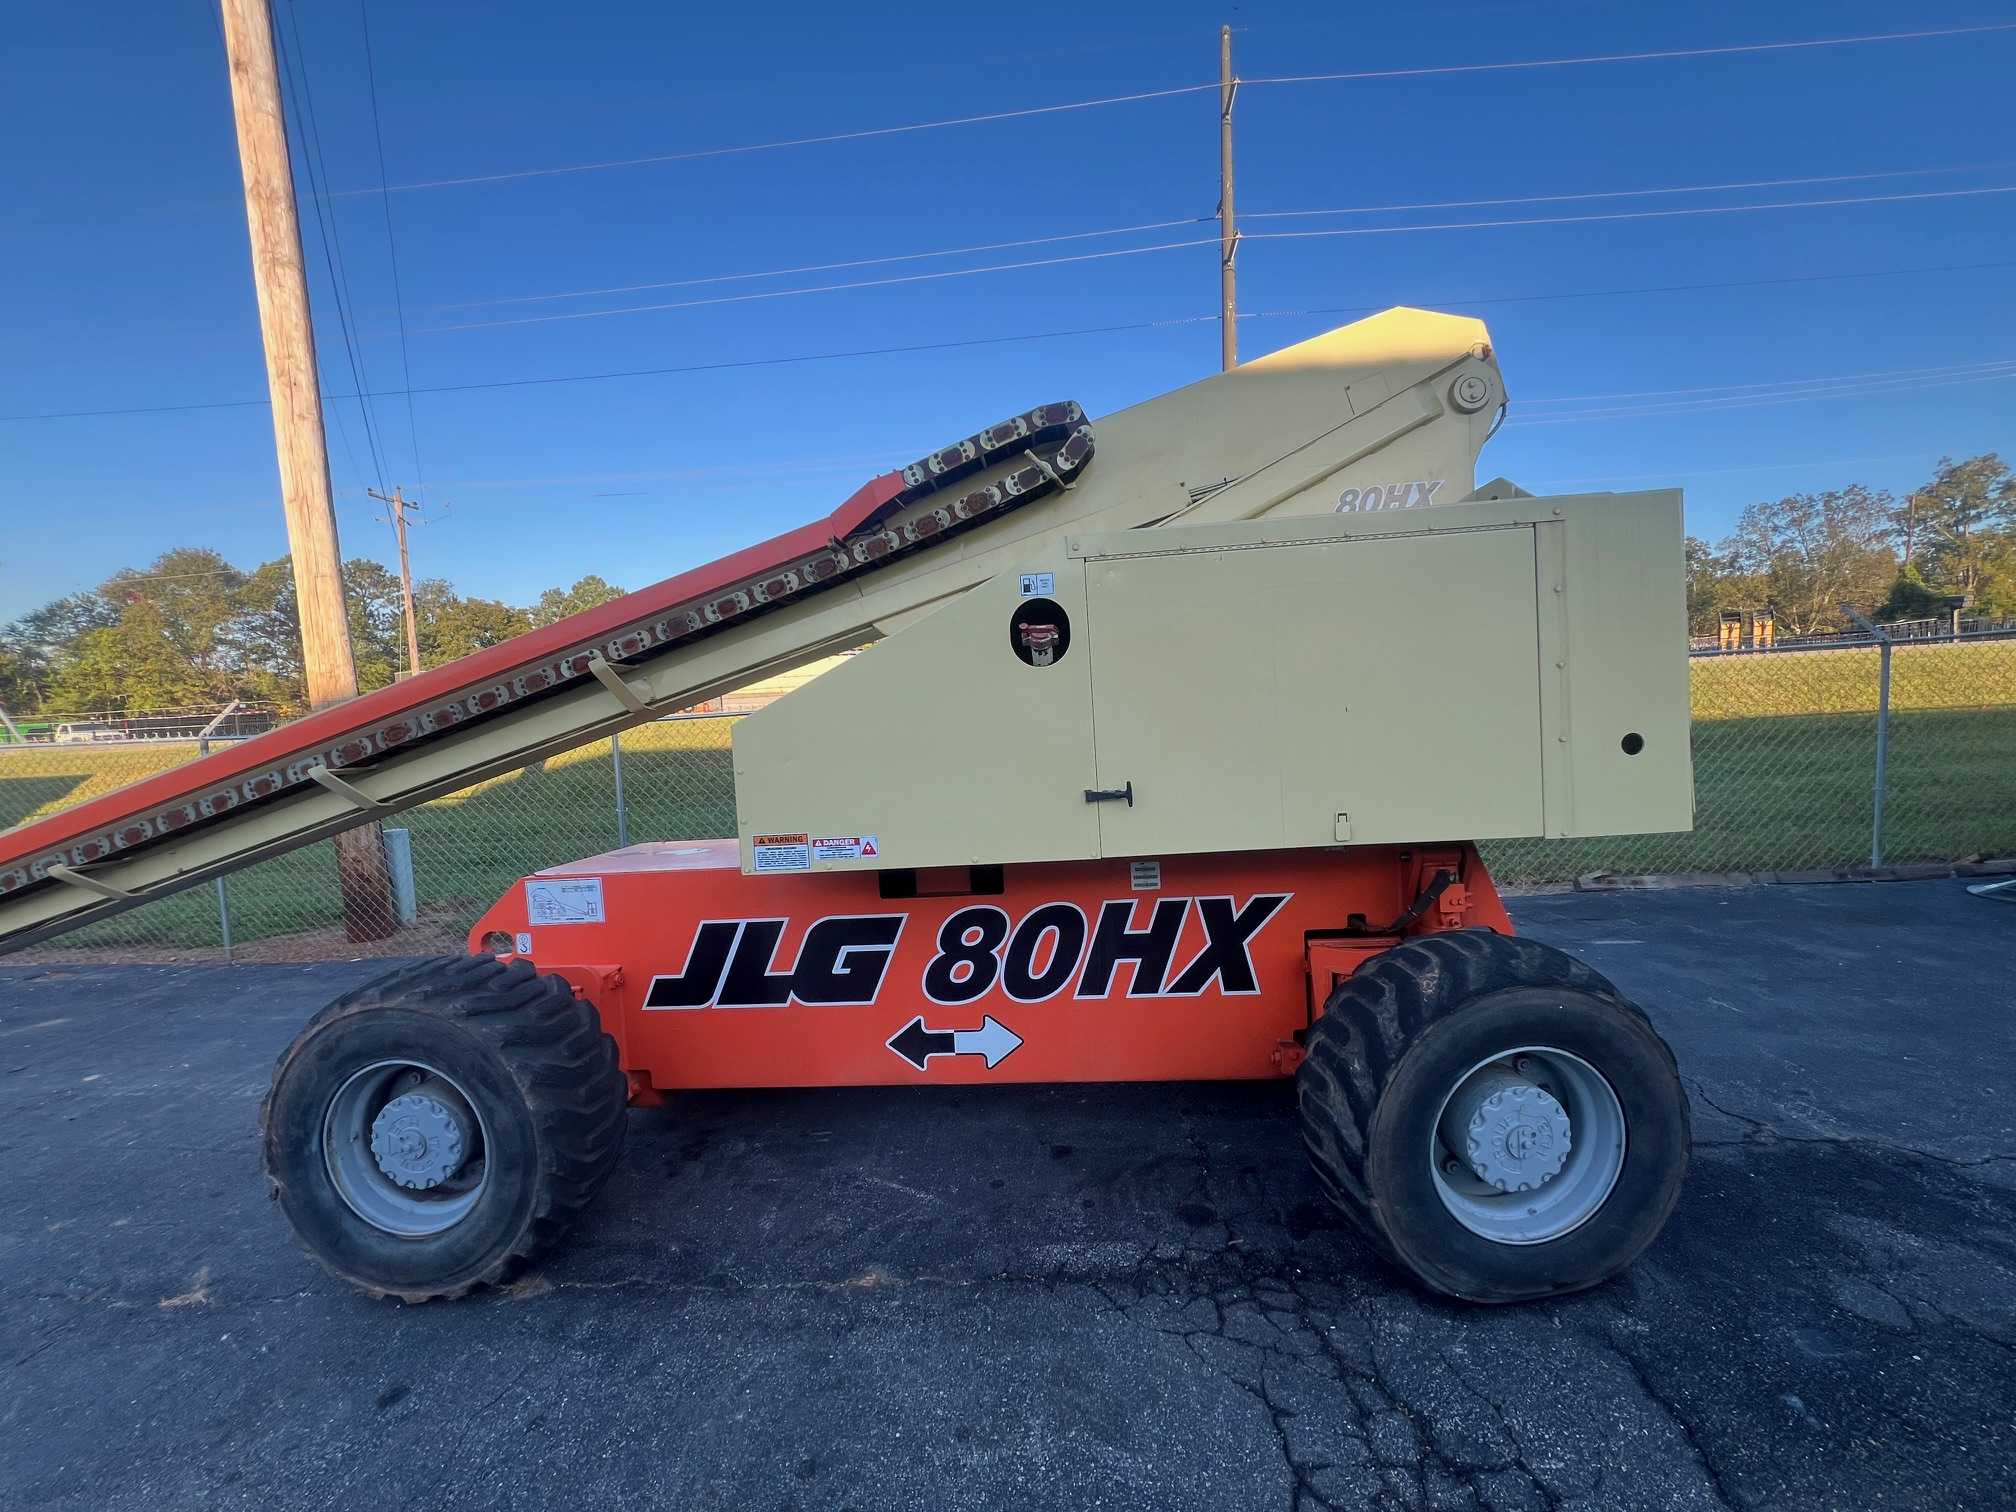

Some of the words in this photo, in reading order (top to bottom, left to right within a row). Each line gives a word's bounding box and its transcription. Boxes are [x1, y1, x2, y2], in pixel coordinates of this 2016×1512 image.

[1334, 480, 1446, 513] 80HX
[767, 835, 803, 844] WARNING
[823, 838, 855, 846] DANGER
[641, 912, 908, 1011] JLG
[922, 892, 1294, 1006] 80HX
